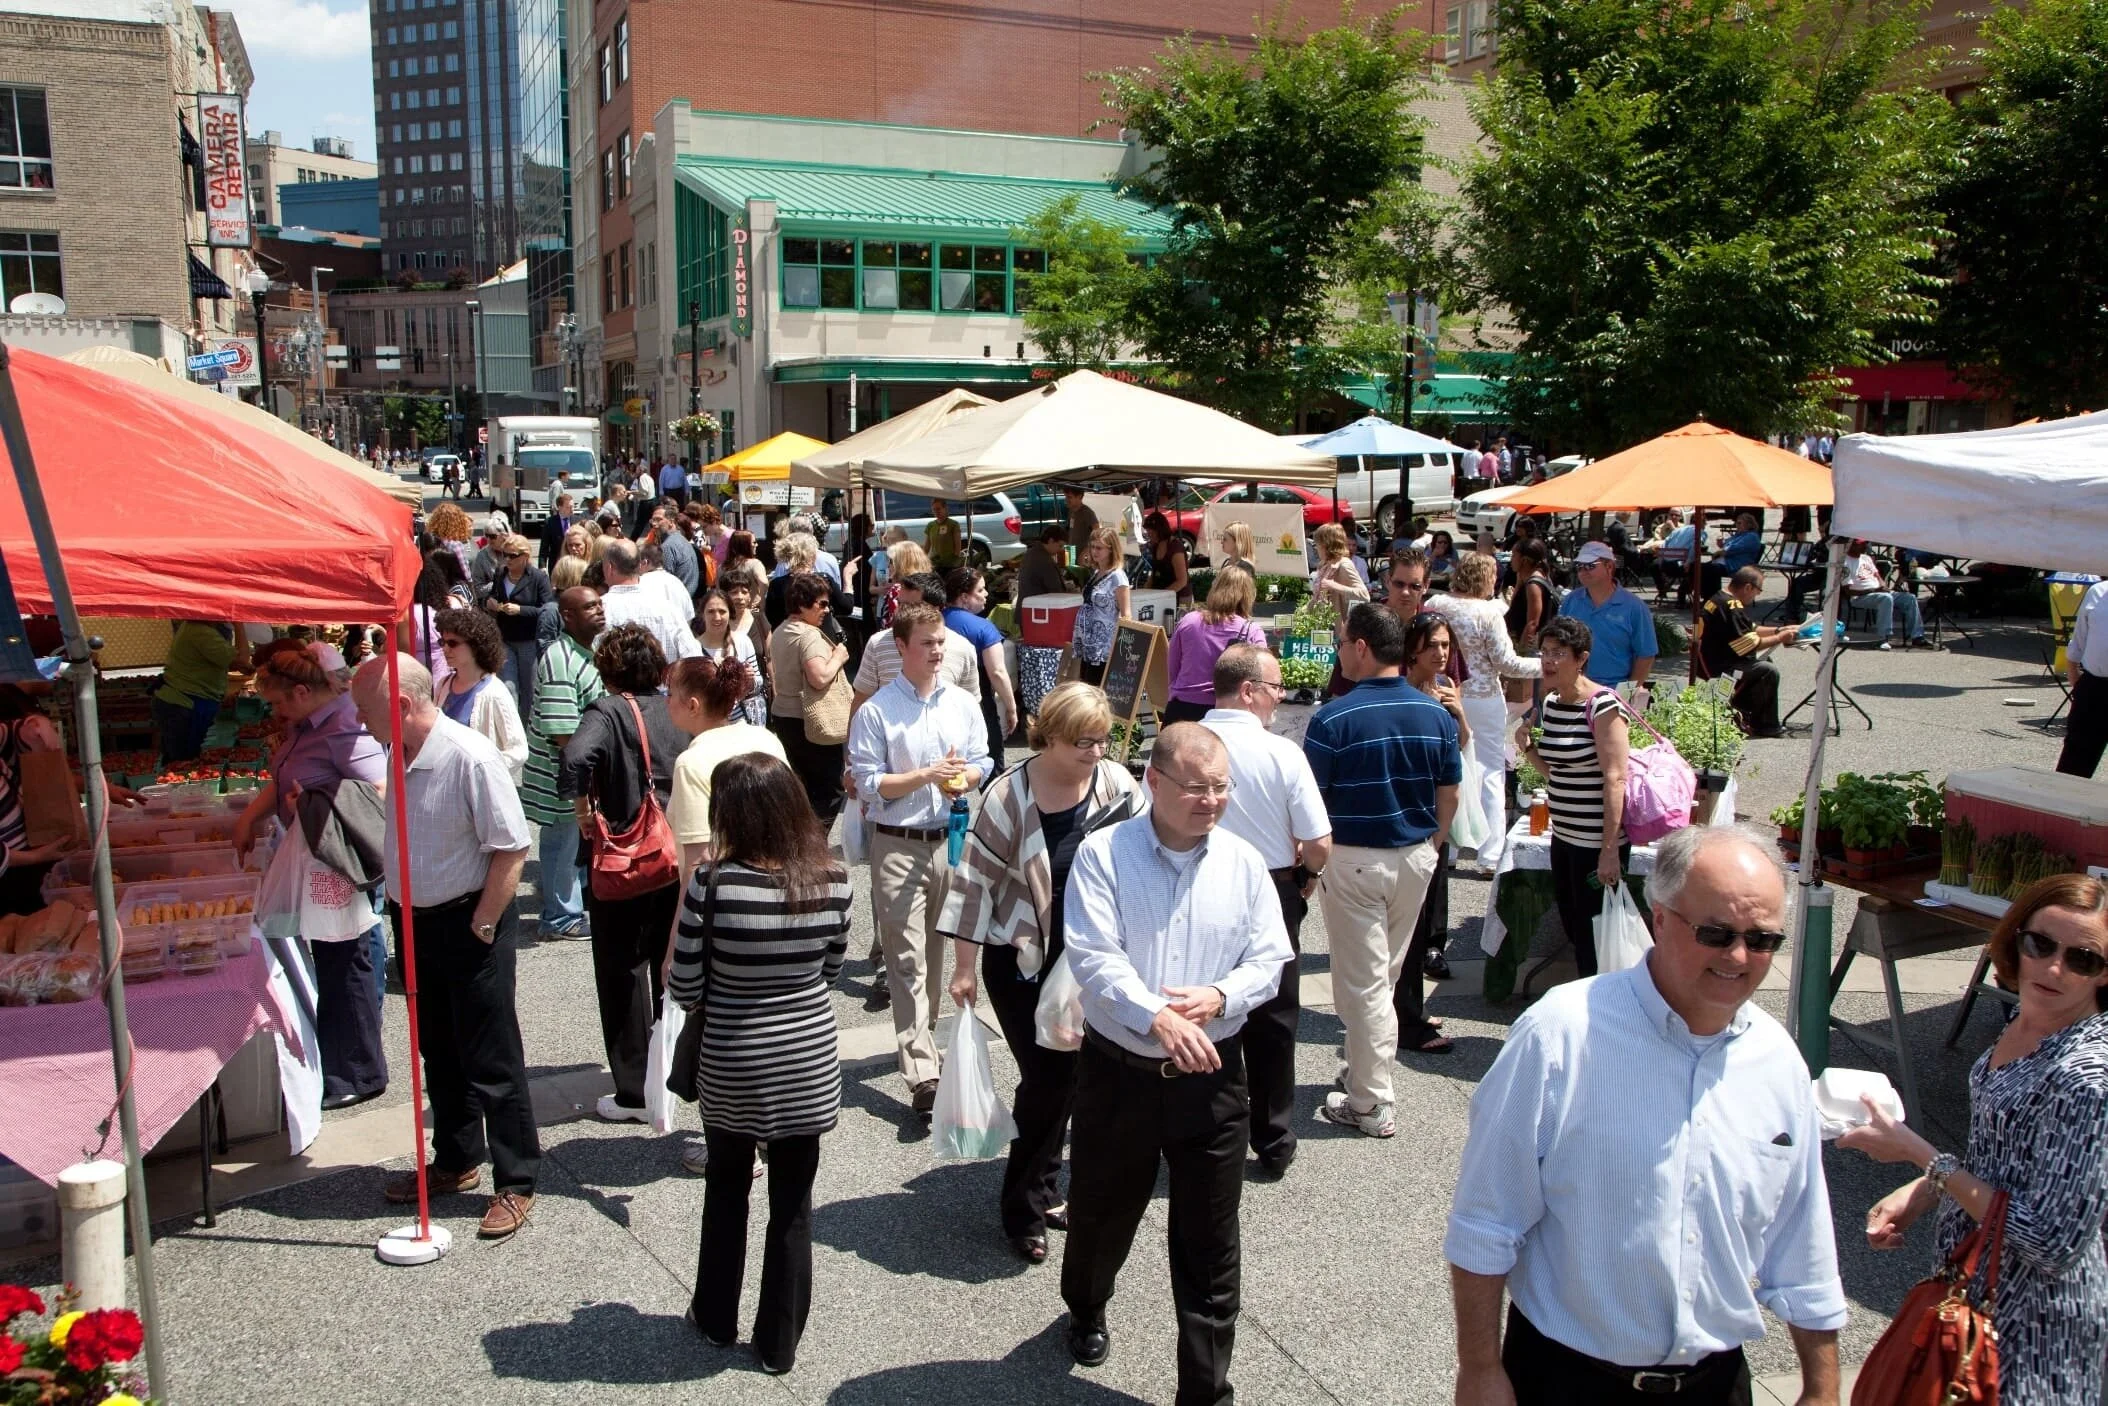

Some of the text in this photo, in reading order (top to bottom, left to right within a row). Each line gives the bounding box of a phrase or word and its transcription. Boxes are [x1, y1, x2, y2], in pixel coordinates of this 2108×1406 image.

[204, 104, 227, 209] CAMERA
[222, 112, 244, 200] REPAIR
[210, 219, 247, 229] SERVICE
[732, 229, 748, 318] DIAMOND
[189, 353, 238, 367] Market Square
